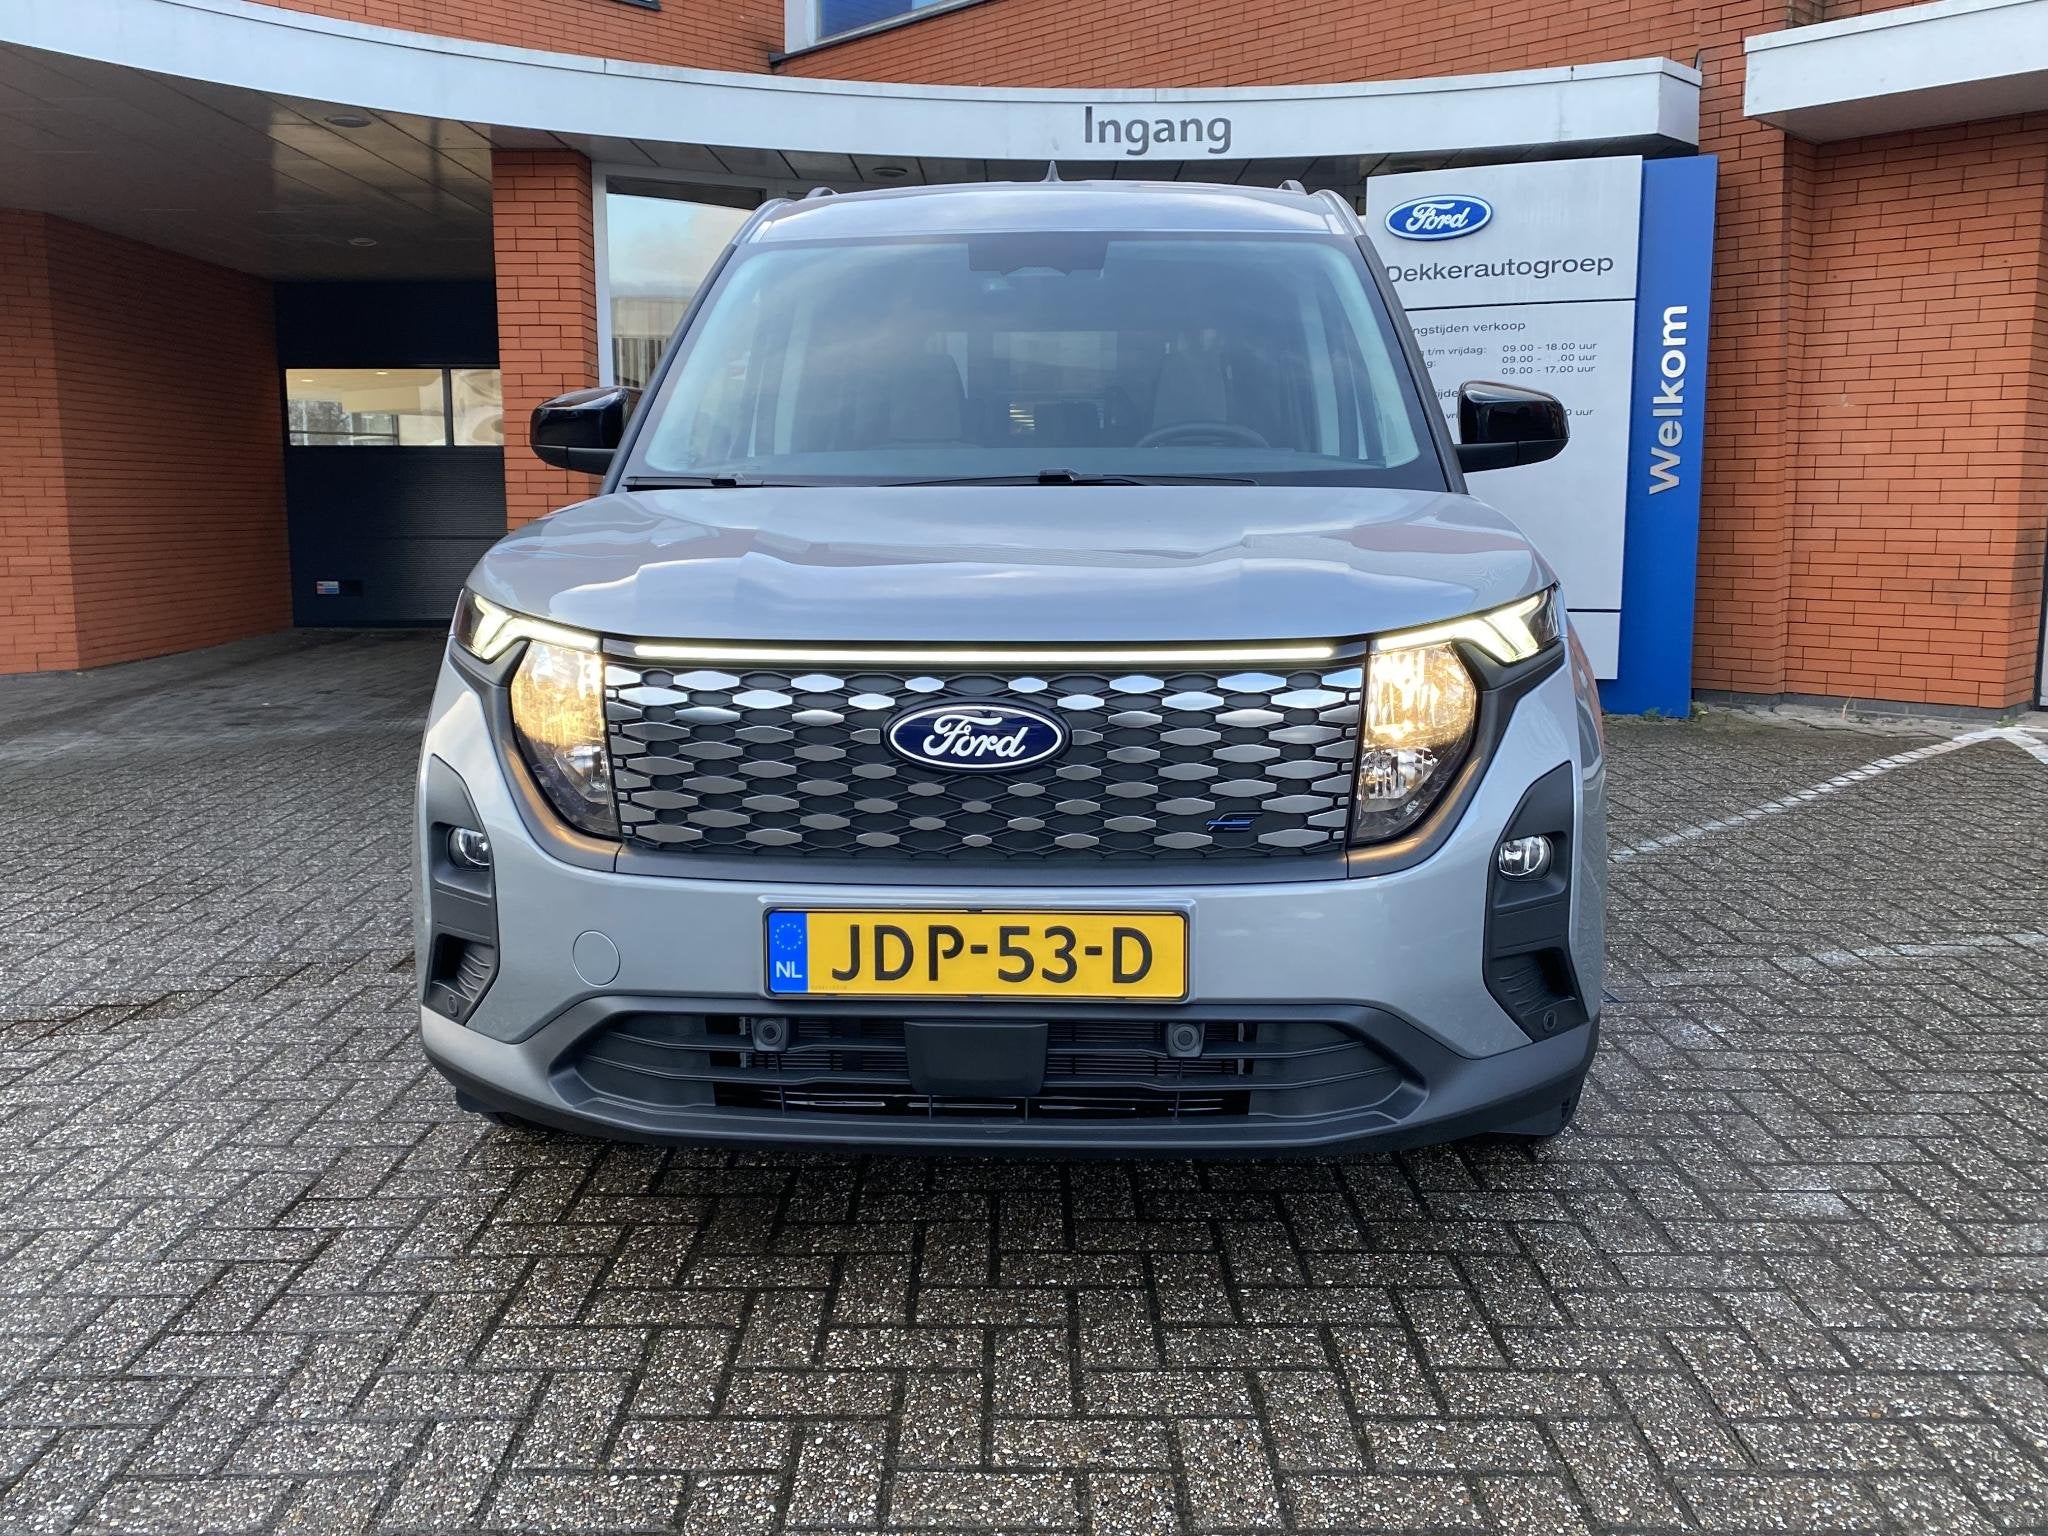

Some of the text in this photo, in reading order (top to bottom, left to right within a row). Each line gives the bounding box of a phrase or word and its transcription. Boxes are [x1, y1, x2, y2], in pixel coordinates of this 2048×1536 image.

[1084, 105, 1232, 156] Ingang
[1405, 202, 1471, 232] Ford
[1387, 256, 1615, 283] Dekkerautogroep
[1413, 321, 1526, 336] ngstijden verkoop
[1427, 347, 1445, 356] t/m
[1448, 345, 1487, 356] vrijdag:
[1502, 344, 1534, 353] 09.00
[1545, 342, 1575, 351] 18.00
[1579, 342, 1598, 350] uur
[1502, 355, 1534, 364] 09.00
[1501, 366, 1533, 375] 09.00
[1545, 365, 1574, 374] 17.00
[1577, 365, 1596, 373] uur
[1648, 305, 1688, 495] Welkom
[1575, 408, 1594, 416] uur
[922, 714, 1029, 758] Ford
[831, 923, 1153, 984] JDP-53-D
[775, 960, 804, 979] NL
